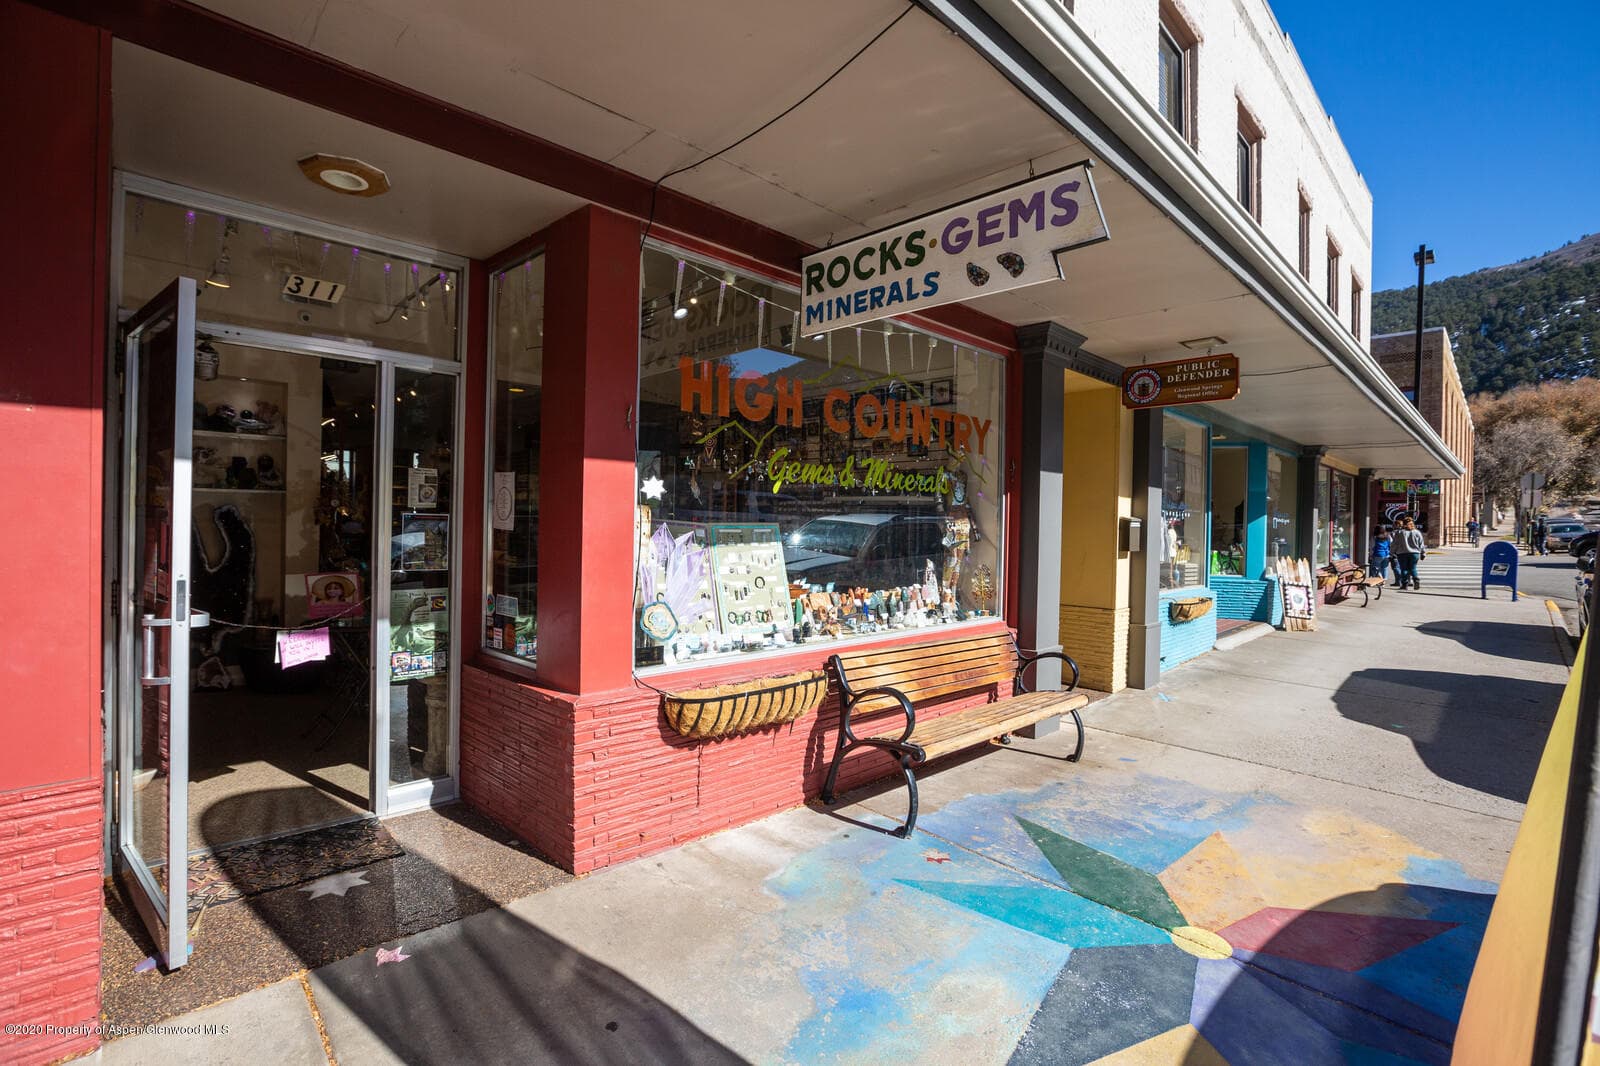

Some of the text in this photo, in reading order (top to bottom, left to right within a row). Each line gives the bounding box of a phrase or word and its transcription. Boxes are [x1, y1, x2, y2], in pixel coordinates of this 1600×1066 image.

[805, 181, 1081, 297] ROCKS GEMS
[287, 276, 338, 301] 311
[806, 271, 941, 326] MINERALS
[1167, 368, 1230, 383] DEFENDER
[1176, 360, 1220, 373] PUBLIC
[679, 356, 992, 455] HIGH COUNTRY
[768, 447, 951, 494] Gems & Minerals
